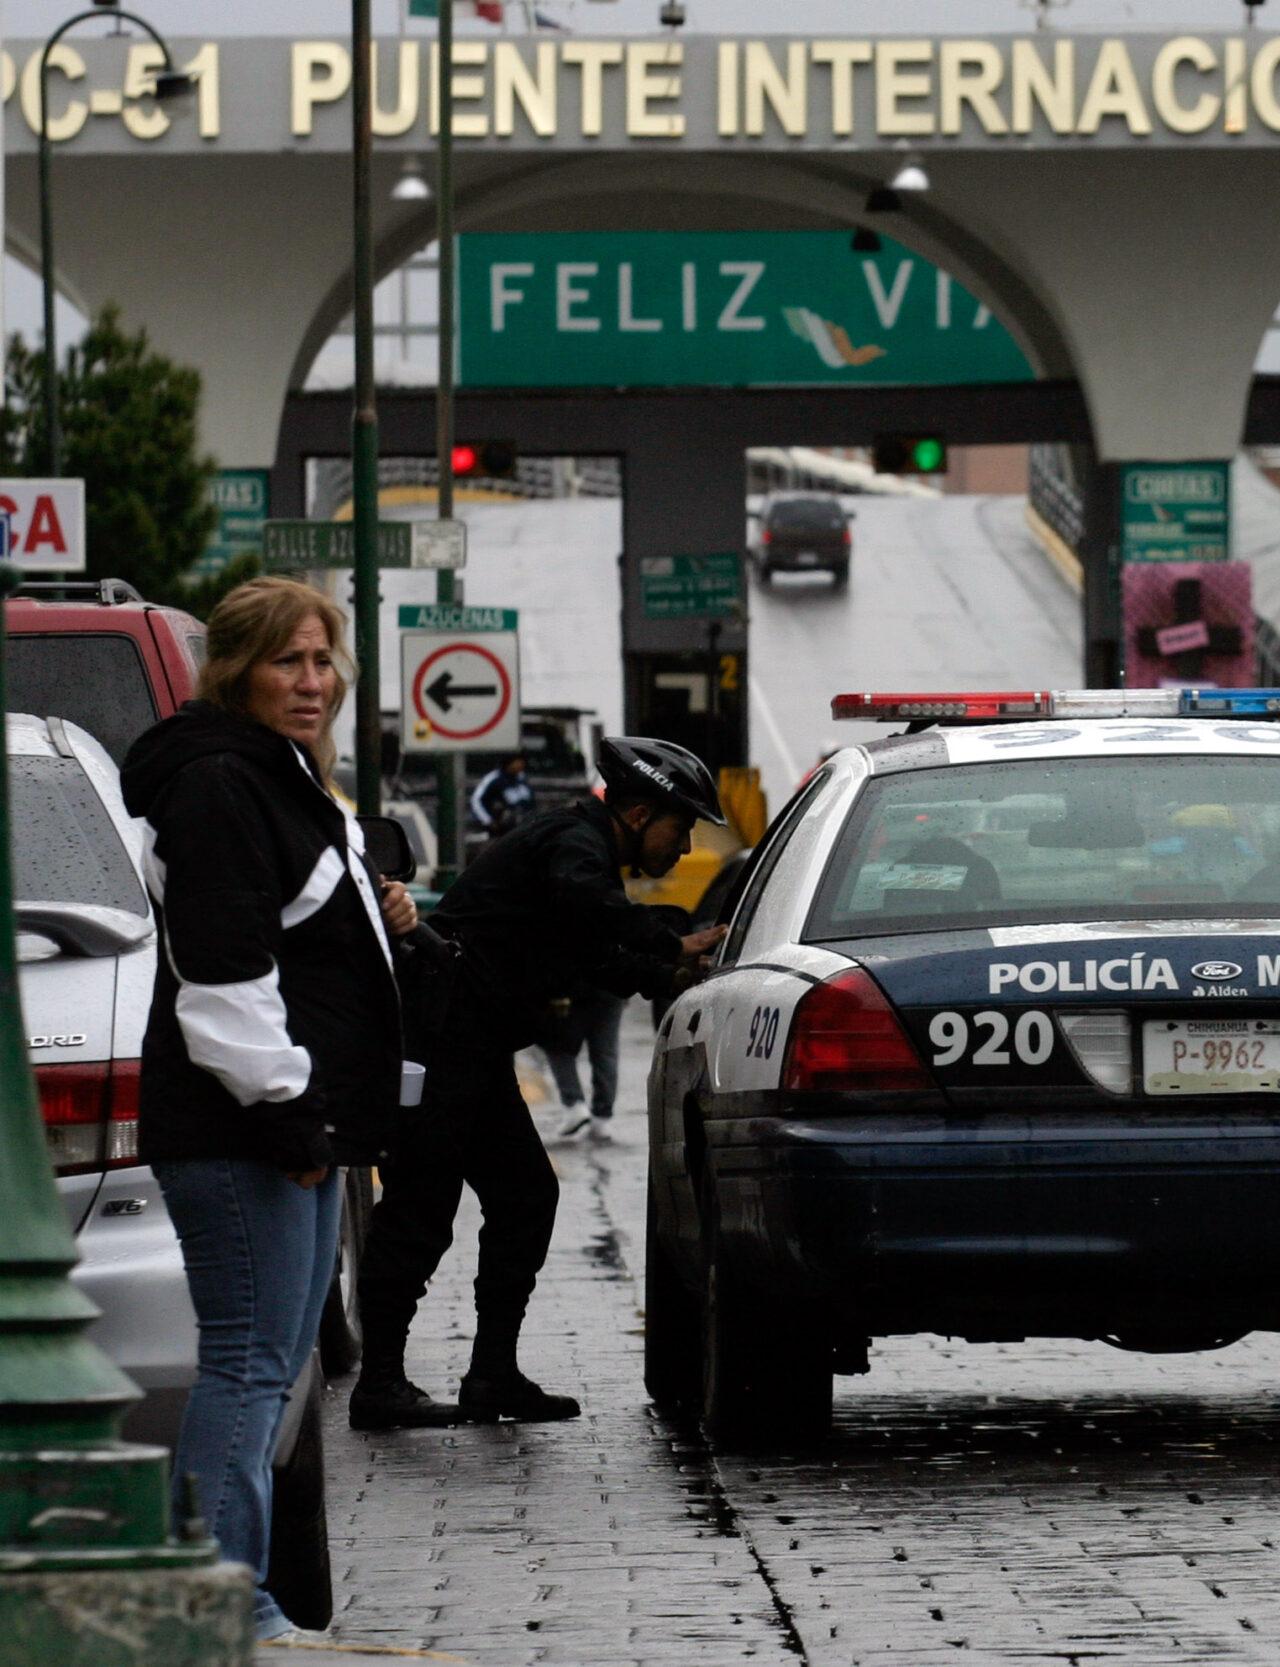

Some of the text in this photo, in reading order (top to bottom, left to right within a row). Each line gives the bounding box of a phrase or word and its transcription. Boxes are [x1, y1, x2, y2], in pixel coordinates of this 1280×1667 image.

[0, 42, 220, 141] C-51
[291, 40, 687, 136] PUENTE
[490, 262, 766, 331] FELIZ
[266, 527, 316, 558] CALLE
[416, 607, 504, 628] AZUCENAS
[720, 654, 738, 690] 2
[632, 759, 675, 792] POLICIA
[989, 951, 1180, 995] POLICÍA
[1207, 985, 1249, 998] Alden
[745, 1005, 780, 1060] 920
[928, 1010, 1055, 1067] 920
[1187, 1022, 1249, 1033] CHIHUAHUA
[1172, 1040, 1266, 1073] P-9962
